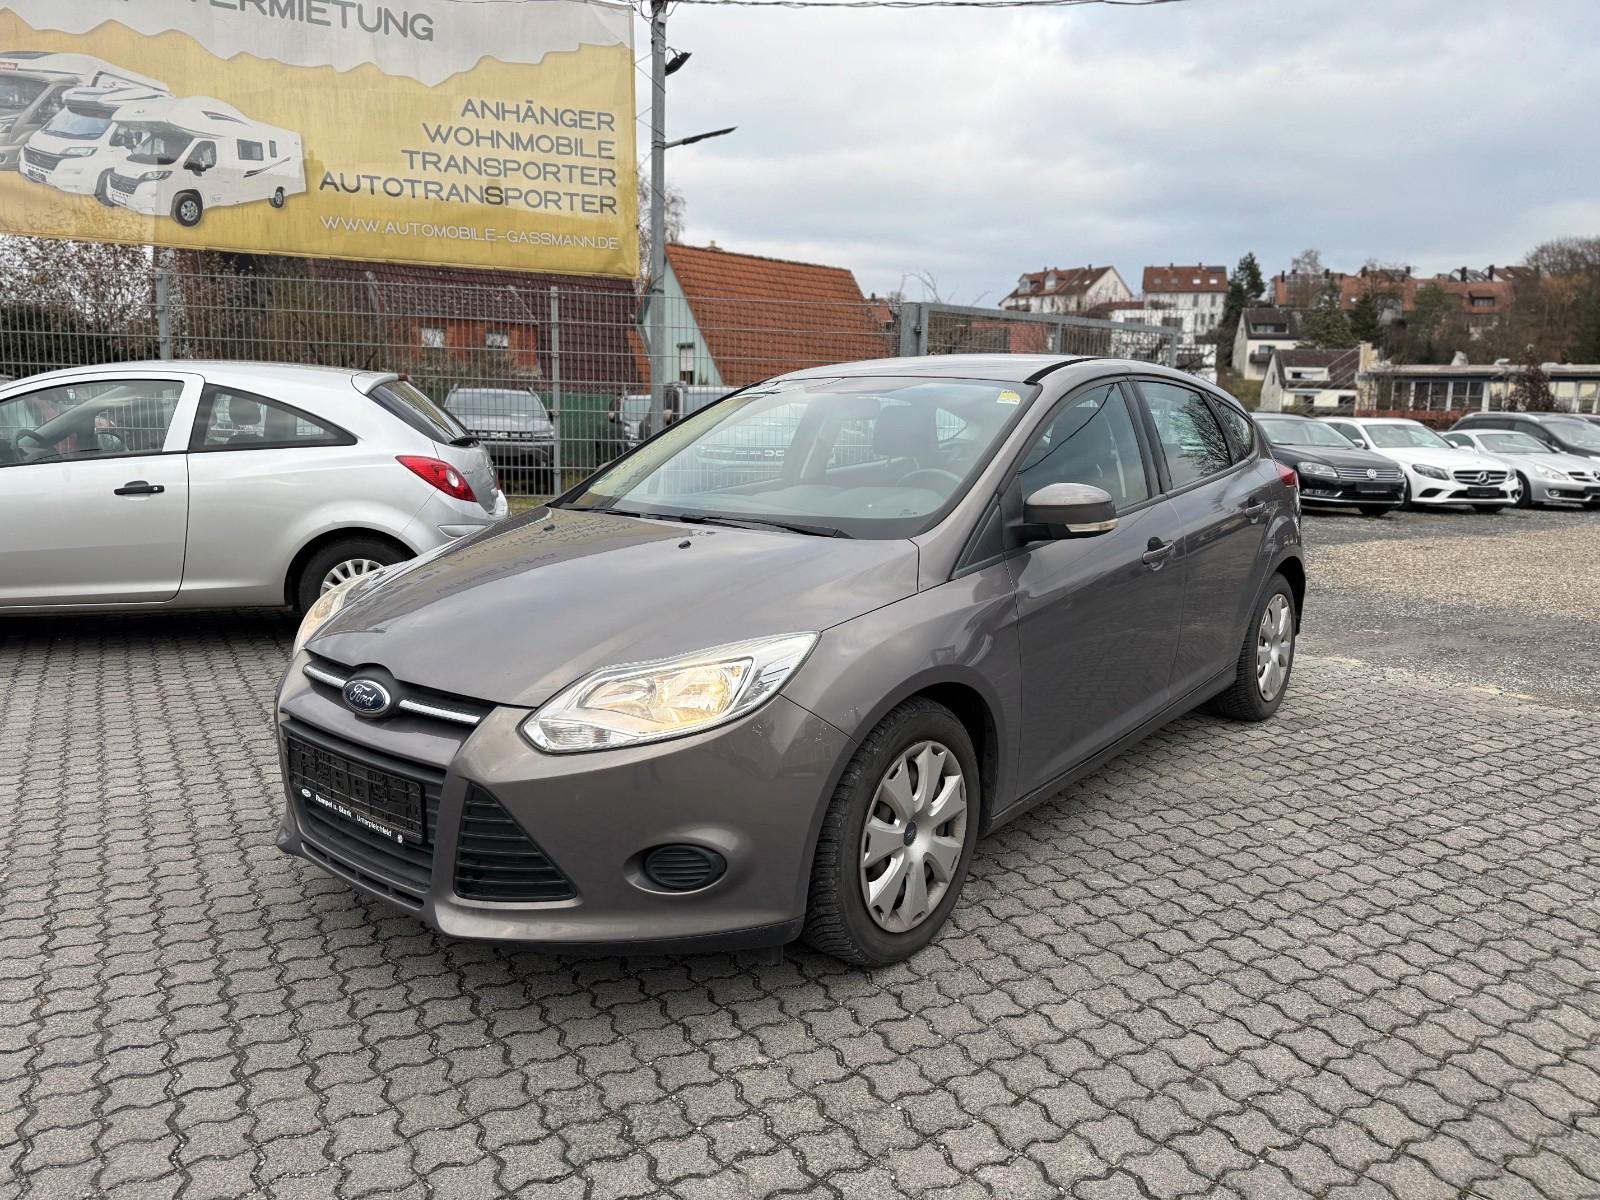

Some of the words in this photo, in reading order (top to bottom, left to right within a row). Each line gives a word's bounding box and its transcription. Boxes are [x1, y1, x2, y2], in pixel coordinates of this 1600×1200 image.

[190, 0, 434, 41] MIETUNG
[461, 98, 615, 132] ANHÄNGER
[422, 122, 616, 160] WOHNMOBILE
[401, 149, 617, 187] TRANSPORTER
[319, 171, 617, 215] AUTOTRANSPORTER
[320, 215, 619, 250] WWW.AUTOMOBILE-GASSMANN.DE
[349, 683, 377, 707] Ford
